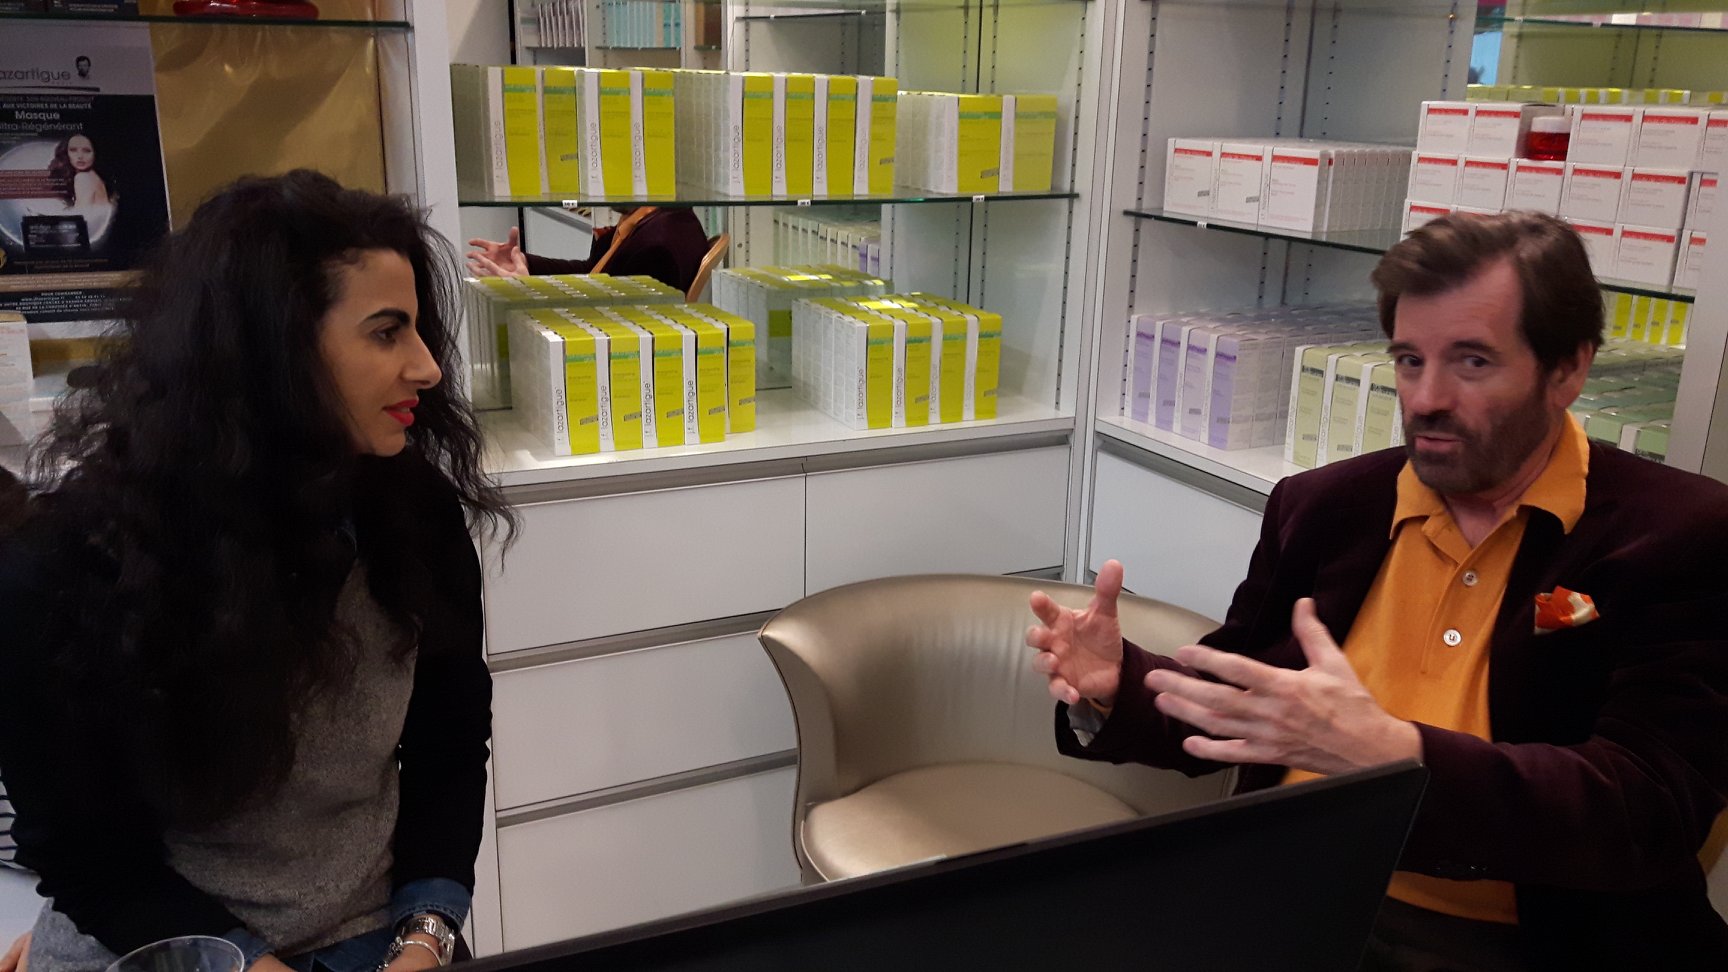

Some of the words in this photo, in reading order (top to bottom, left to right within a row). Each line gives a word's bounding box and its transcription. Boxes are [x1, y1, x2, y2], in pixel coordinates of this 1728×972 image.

[0, 68, 71, 82] azartigue
[15, 110, 60, 121] Masque
[0, 122, 83, 132] ltra-Régénérant
[645, 382, 653, 426] lazartigue
[687, 380, 696, 423] lazartigue
